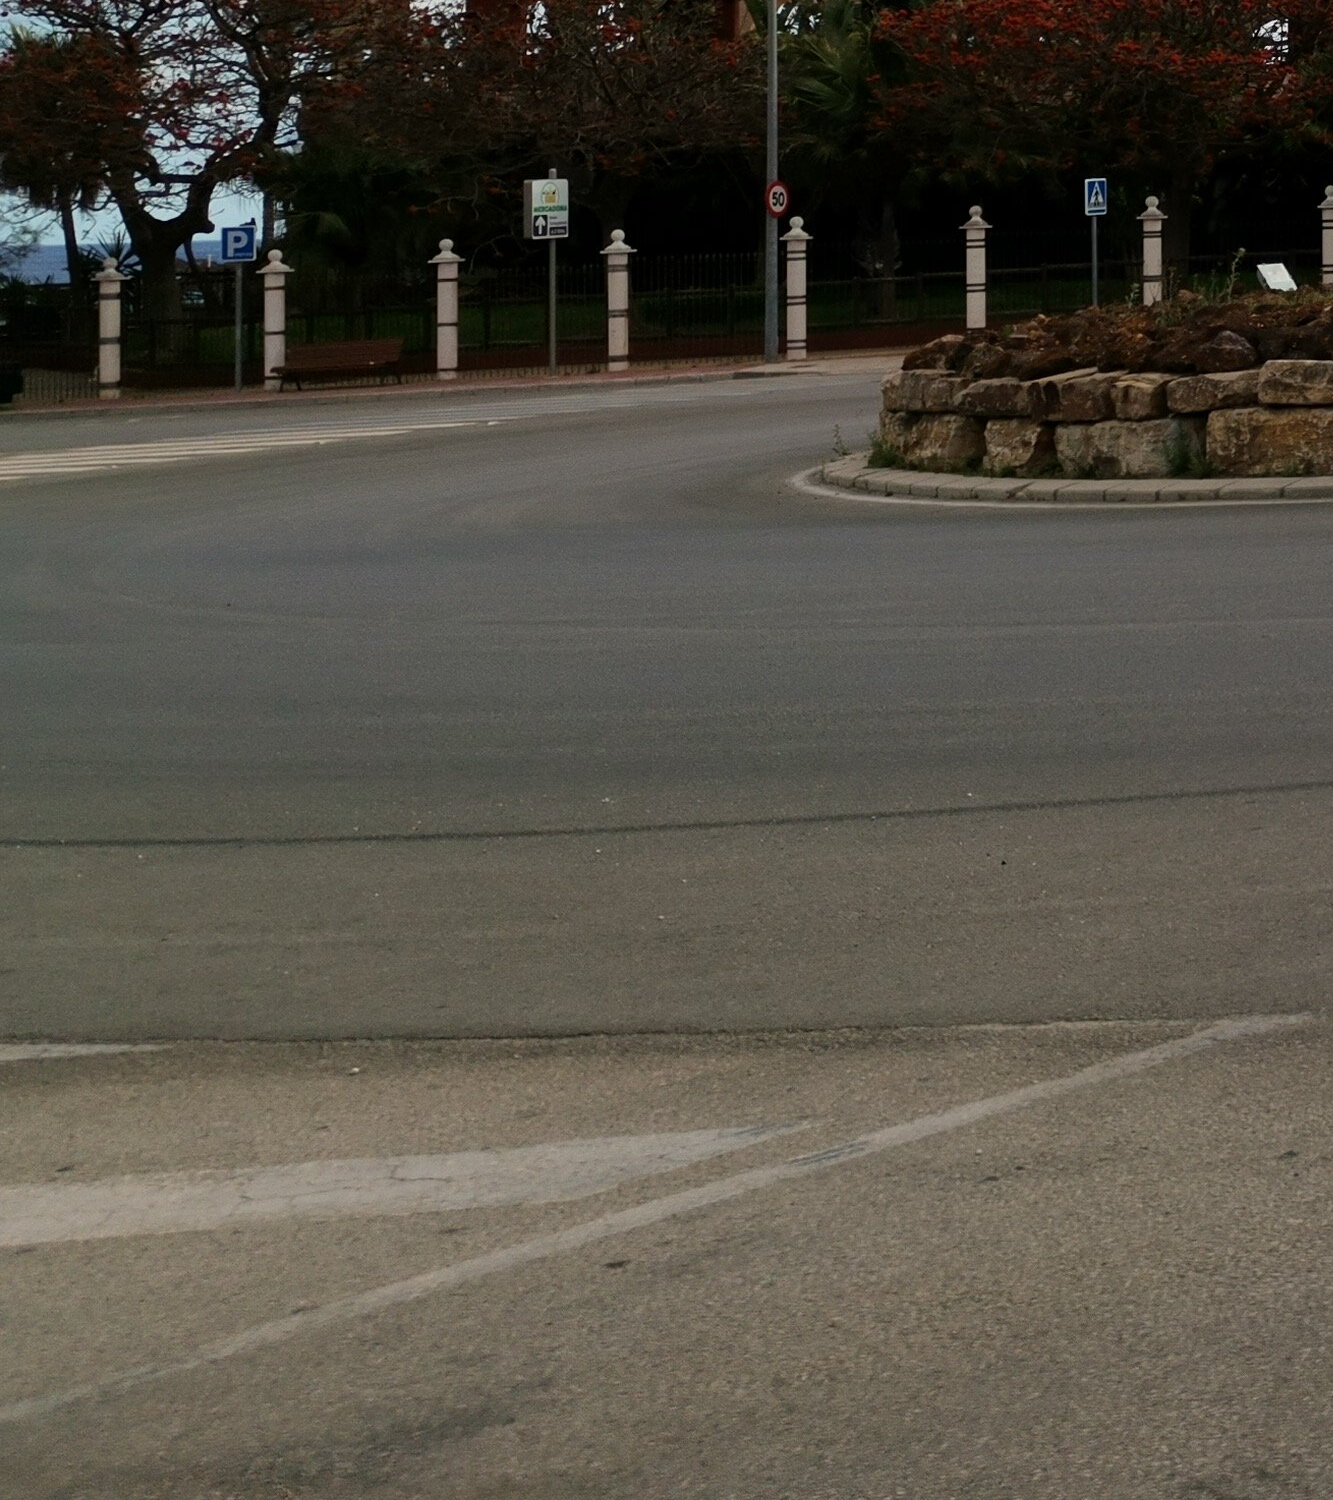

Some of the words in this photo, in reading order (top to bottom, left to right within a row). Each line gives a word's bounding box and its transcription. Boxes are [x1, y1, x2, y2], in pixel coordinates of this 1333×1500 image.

[772, 192, 785, 207] 50
[533, 205, 567, 213] MERCADONA
[227, 231, 248, 257] P
